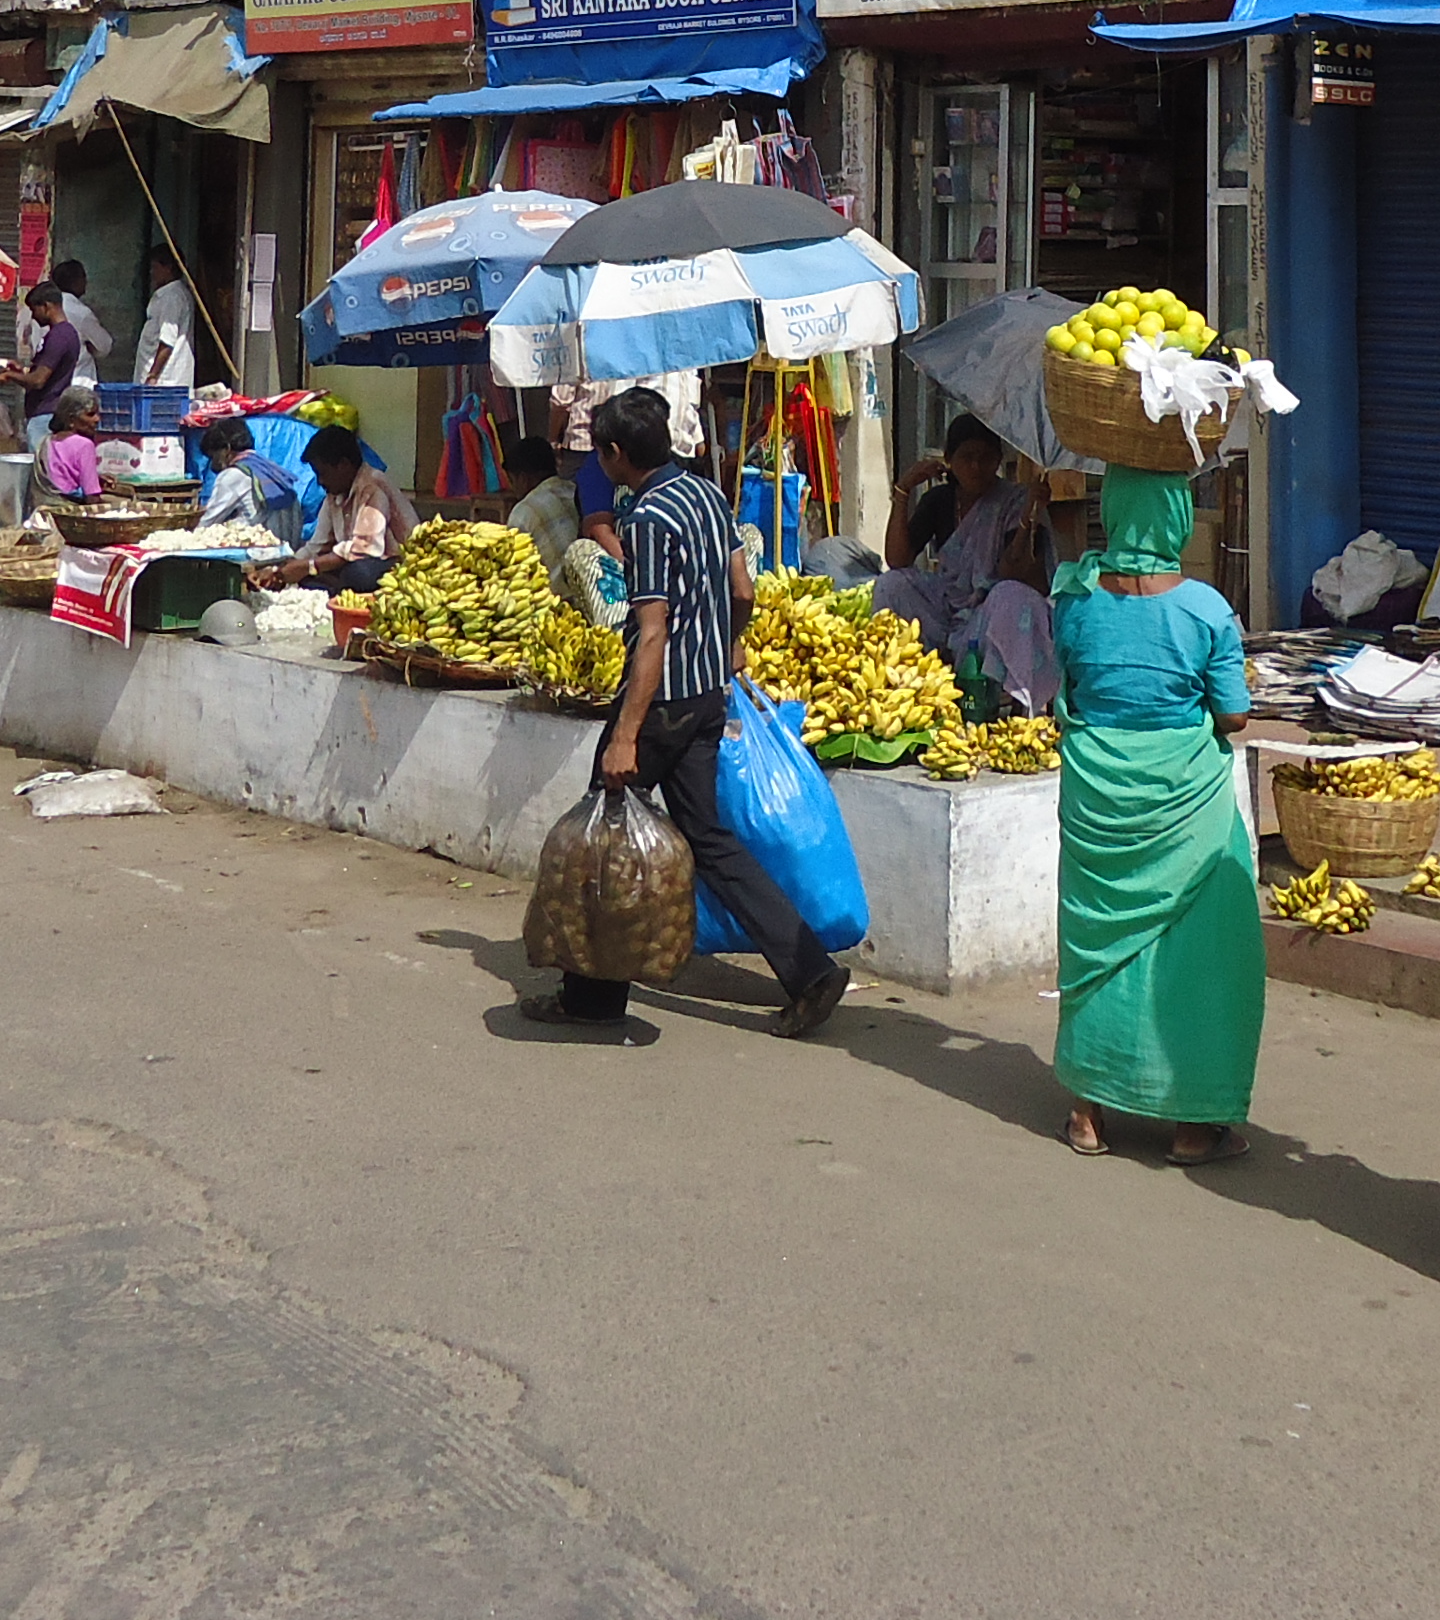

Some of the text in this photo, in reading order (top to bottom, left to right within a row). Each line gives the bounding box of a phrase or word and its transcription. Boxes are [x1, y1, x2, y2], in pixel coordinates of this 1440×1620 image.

[1314, 40, 1372, 59] ZEN
[1315, 86, 1372, 101] SSLC
[411, 276, 471, 299] PEPSI
[781, 303, 814, 317] TATA
